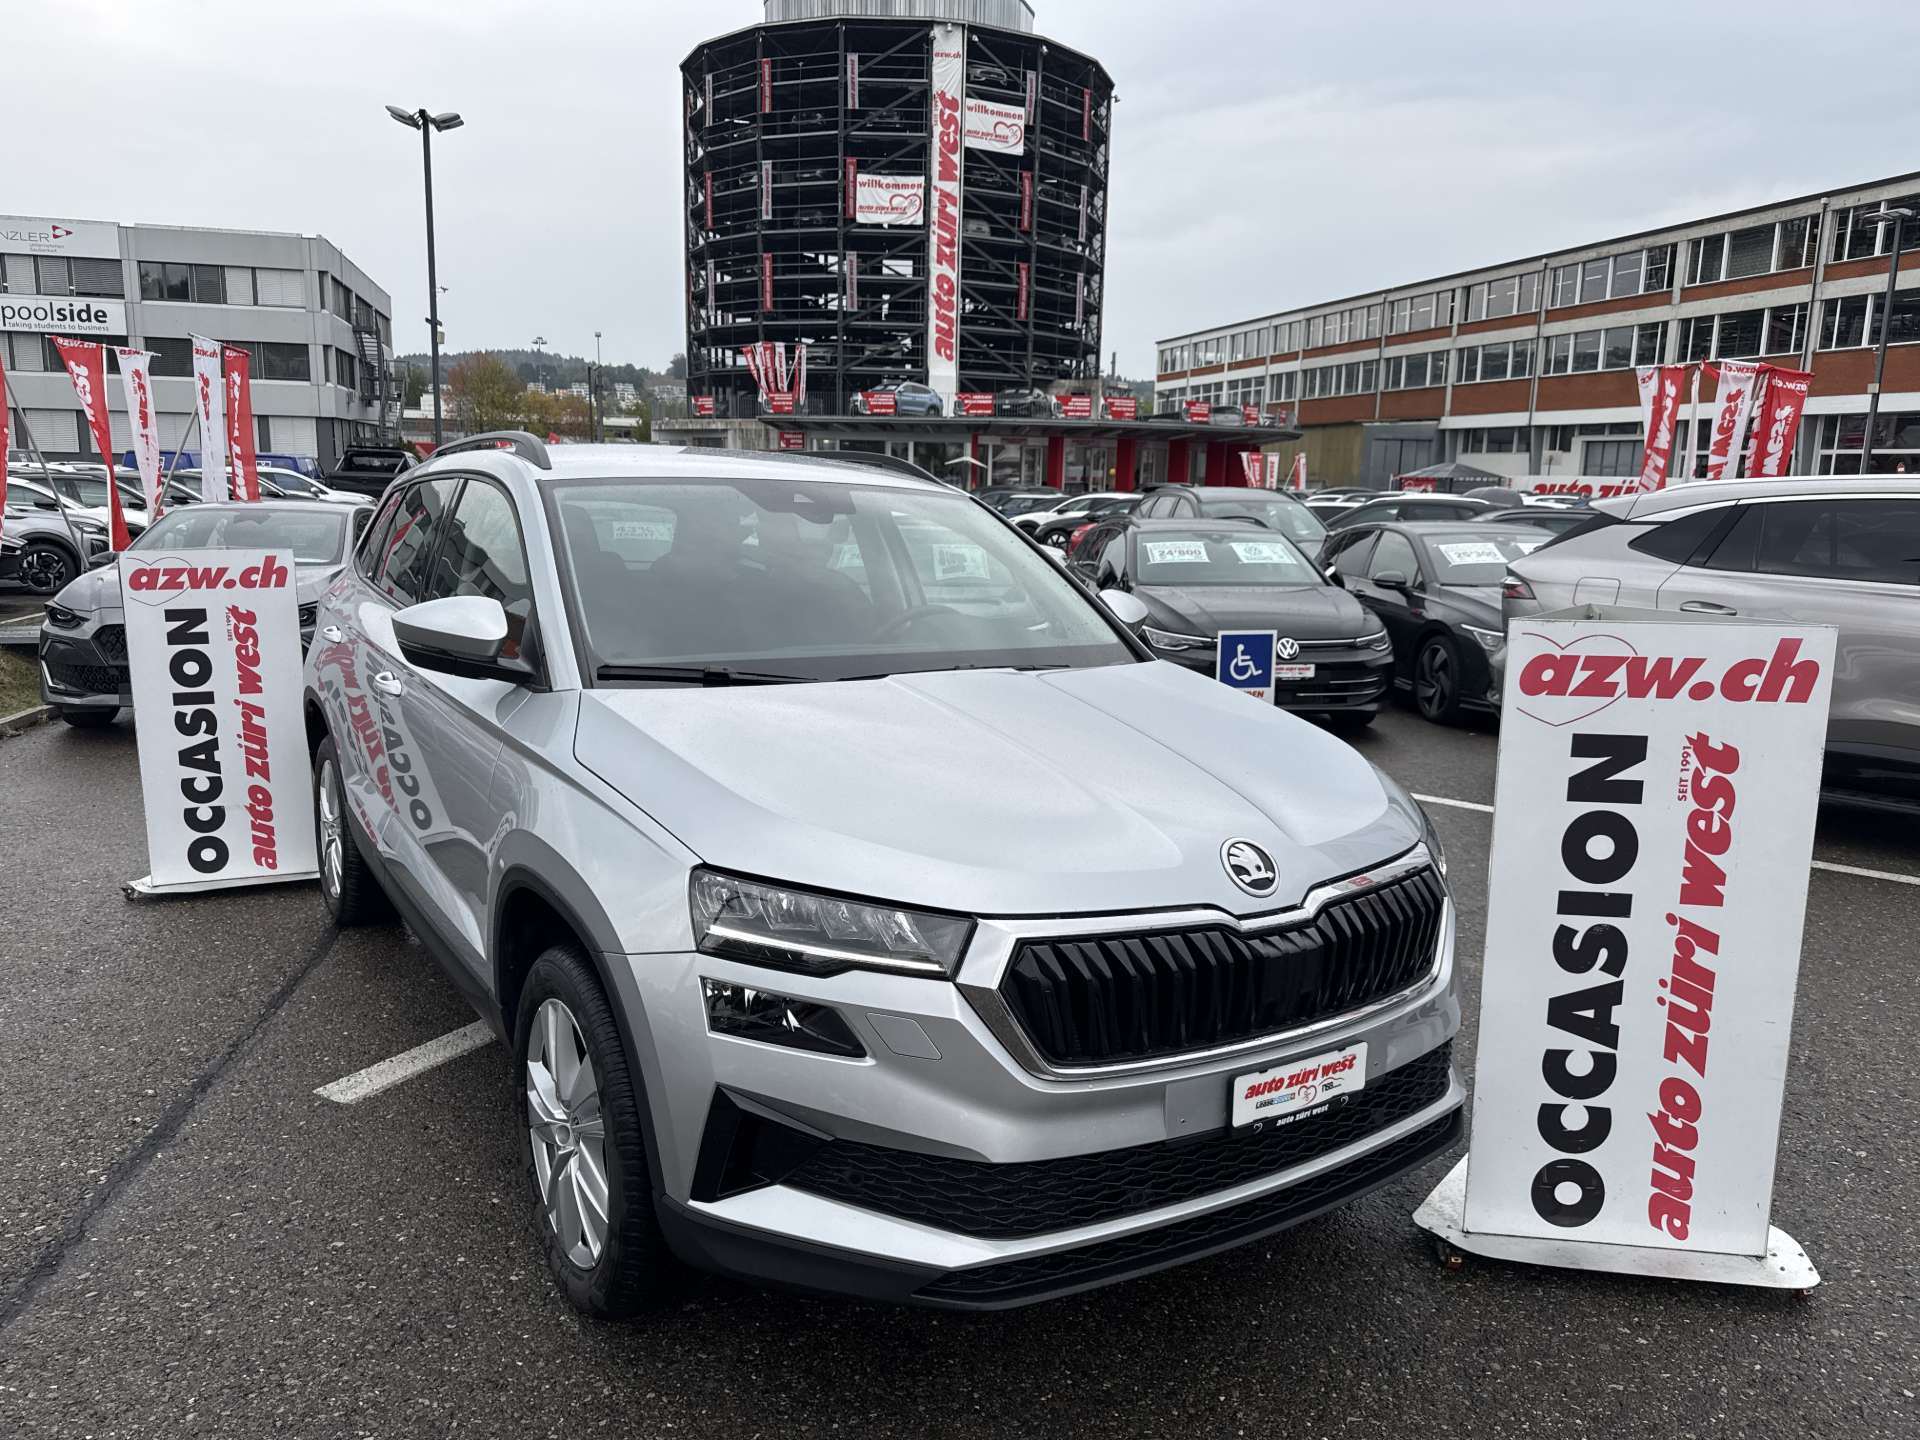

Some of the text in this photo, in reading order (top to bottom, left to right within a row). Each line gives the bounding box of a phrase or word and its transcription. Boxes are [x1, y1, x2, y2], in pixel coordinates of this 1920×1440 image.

[934, 50, 961, 59] azw.ch
[966, 103, 1024, 121] willkommen
[857, 178, 923, 191] willkommen
[932, 90, 960, 362] auto züri west
[1, 301, 108, 327] poolside
[8, 321, 110, 332] taking students to business
[129, 555, 288, 591] azw.ch
[1519, 637, 1820, 703] azw.ch
[164, 608, 230, 874] OCCASION
[226, 605, 278, 870] auto züri west
[1677, 745, 1692, 802] SEIT 1991
[1530, 733, 1649, 1228] OCCASION
[1646, 731, 1740, 1241] auto züri west
[1244, 1053, 1358, 1100] auto züri west
[1276, 1115, 1294, 1127] auto
[1312, 1104, 1329, 1116] west
